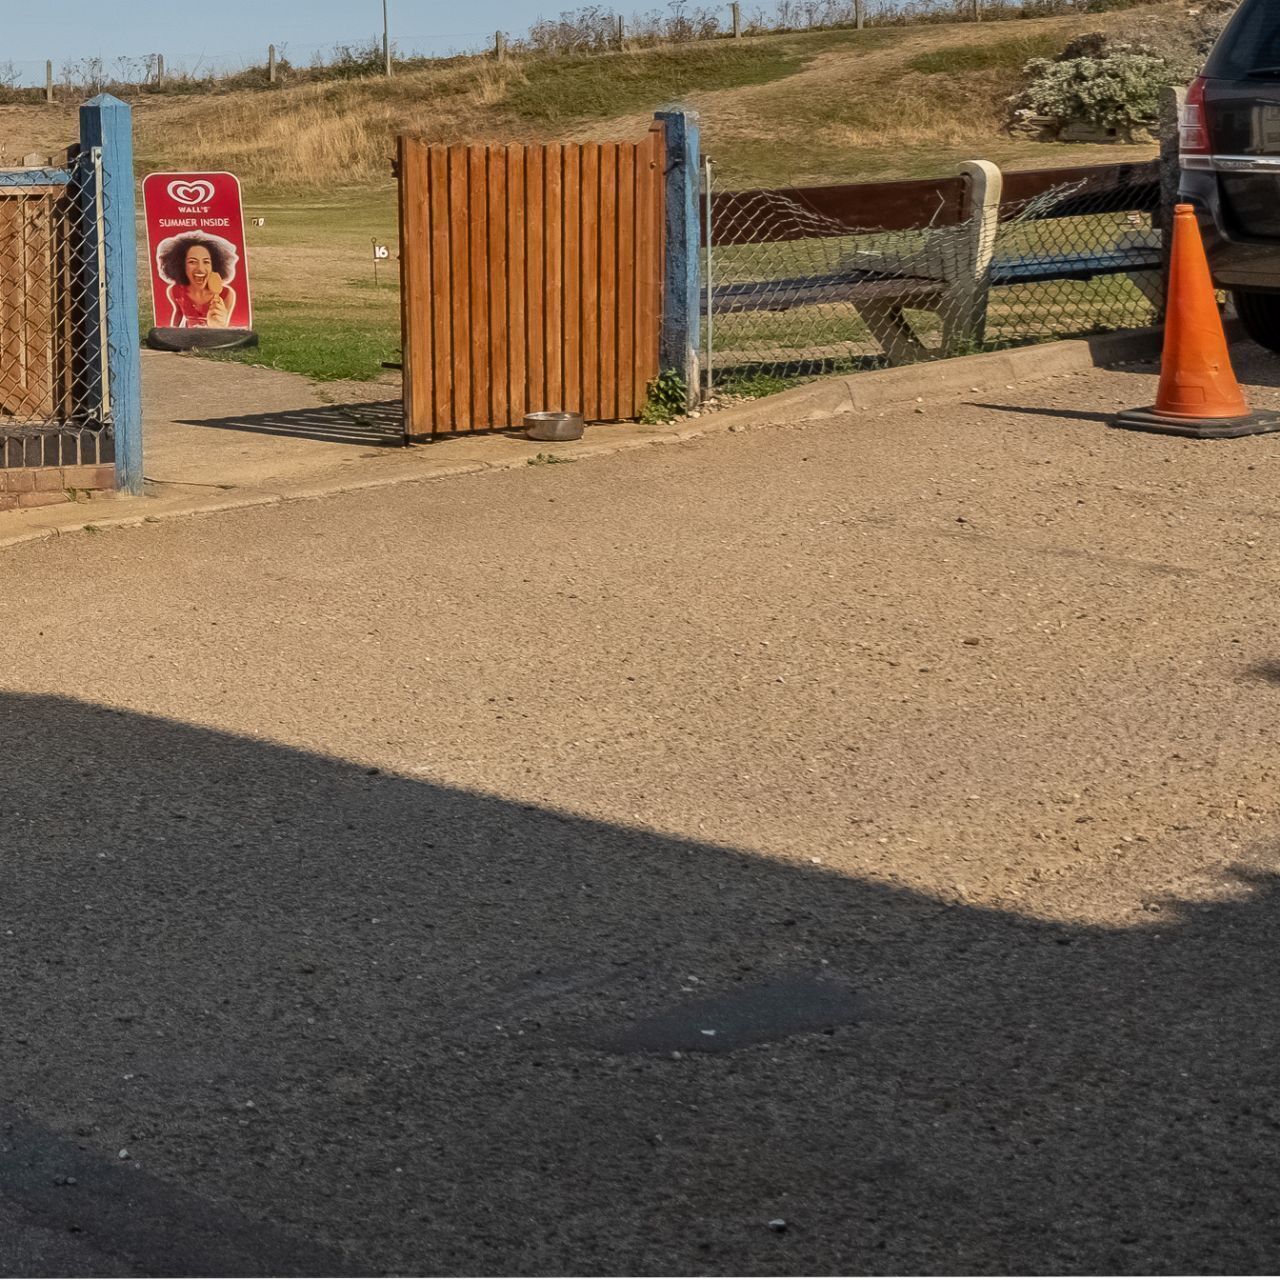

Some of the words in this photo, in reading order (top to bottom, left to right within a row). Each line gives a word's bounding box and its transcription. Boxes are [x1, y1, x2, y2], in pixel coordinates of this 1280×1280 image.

[178, 206, 209, 214] WALL'S
[159, 218, 198, 227] SUMMER
[200, 218, 230, 227] INSIDE
[375, 246, 389, 258] 16
